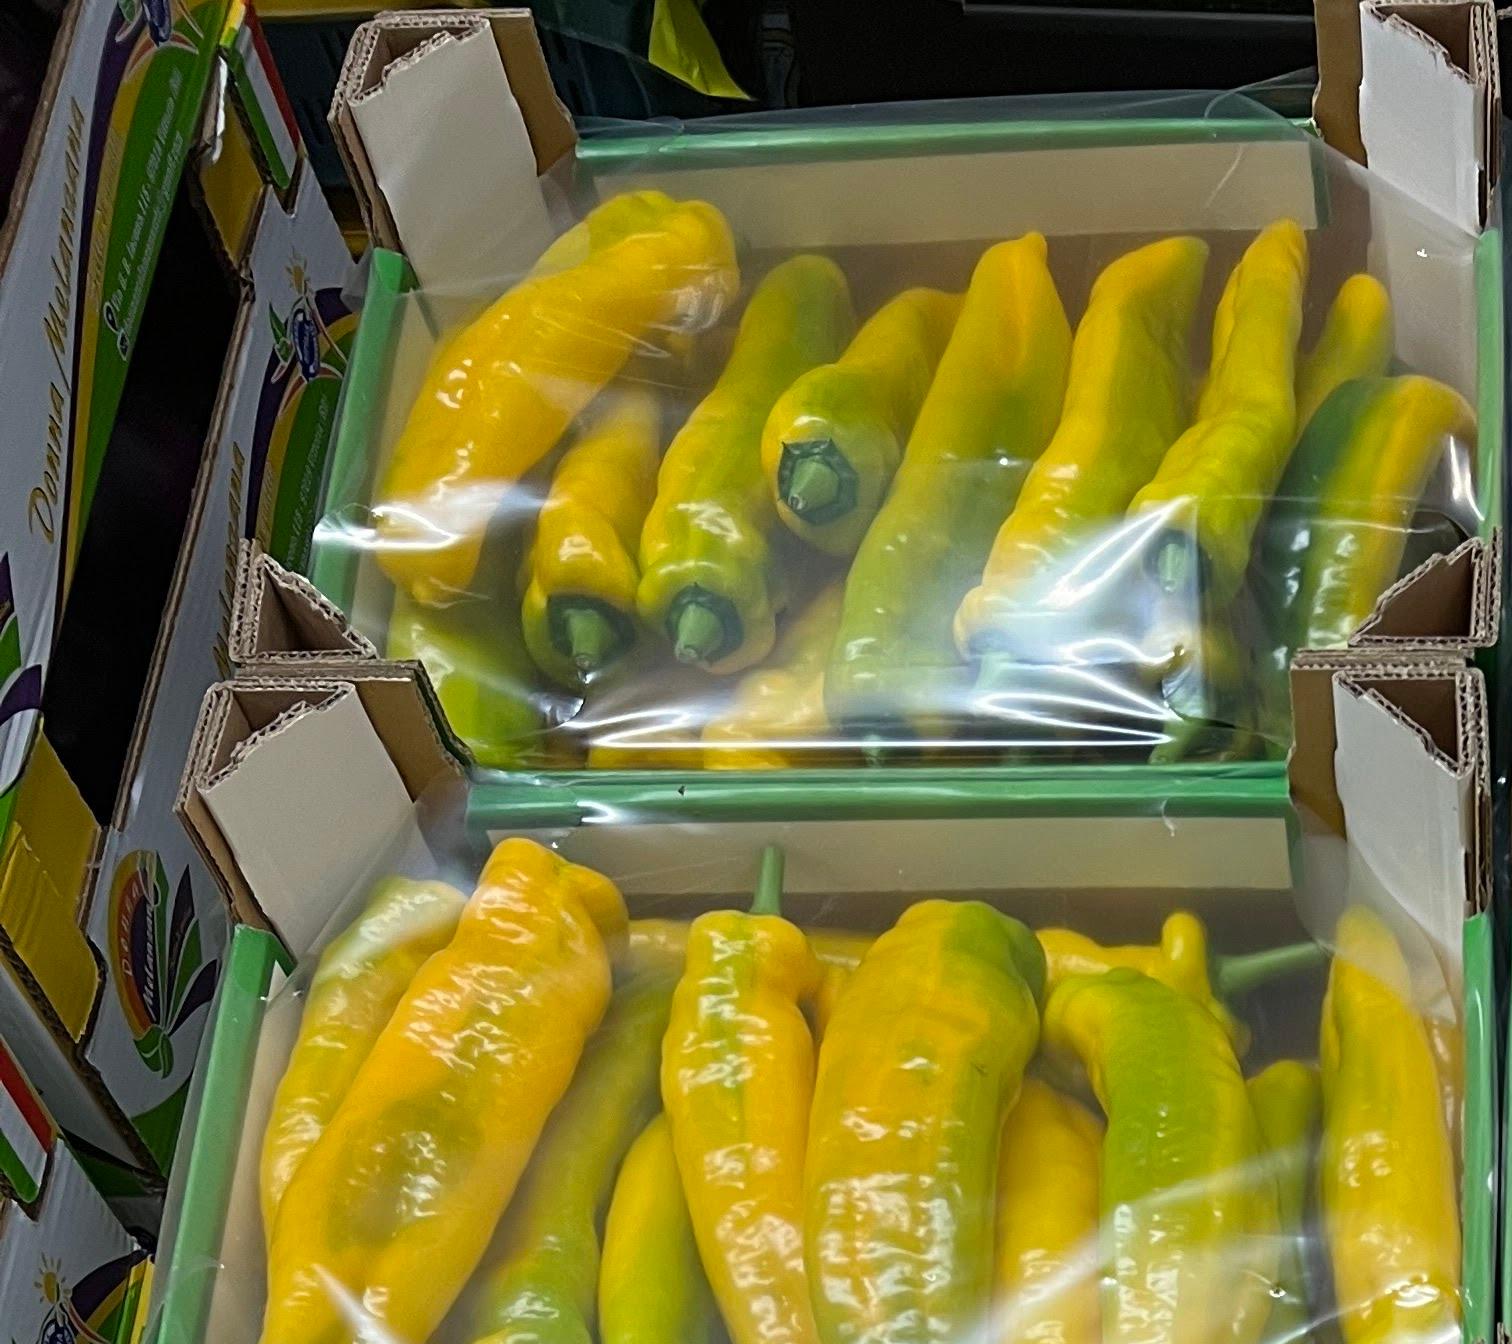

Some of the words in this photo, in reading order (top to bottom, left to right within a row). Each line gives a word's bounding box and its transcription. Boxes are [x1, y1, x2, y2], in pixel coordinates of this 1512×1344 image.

[44, 96, 85, 392] Melanzana
[28, 381, 65, 545] Donna
[143, 901, 158, 1022] Melanzan
